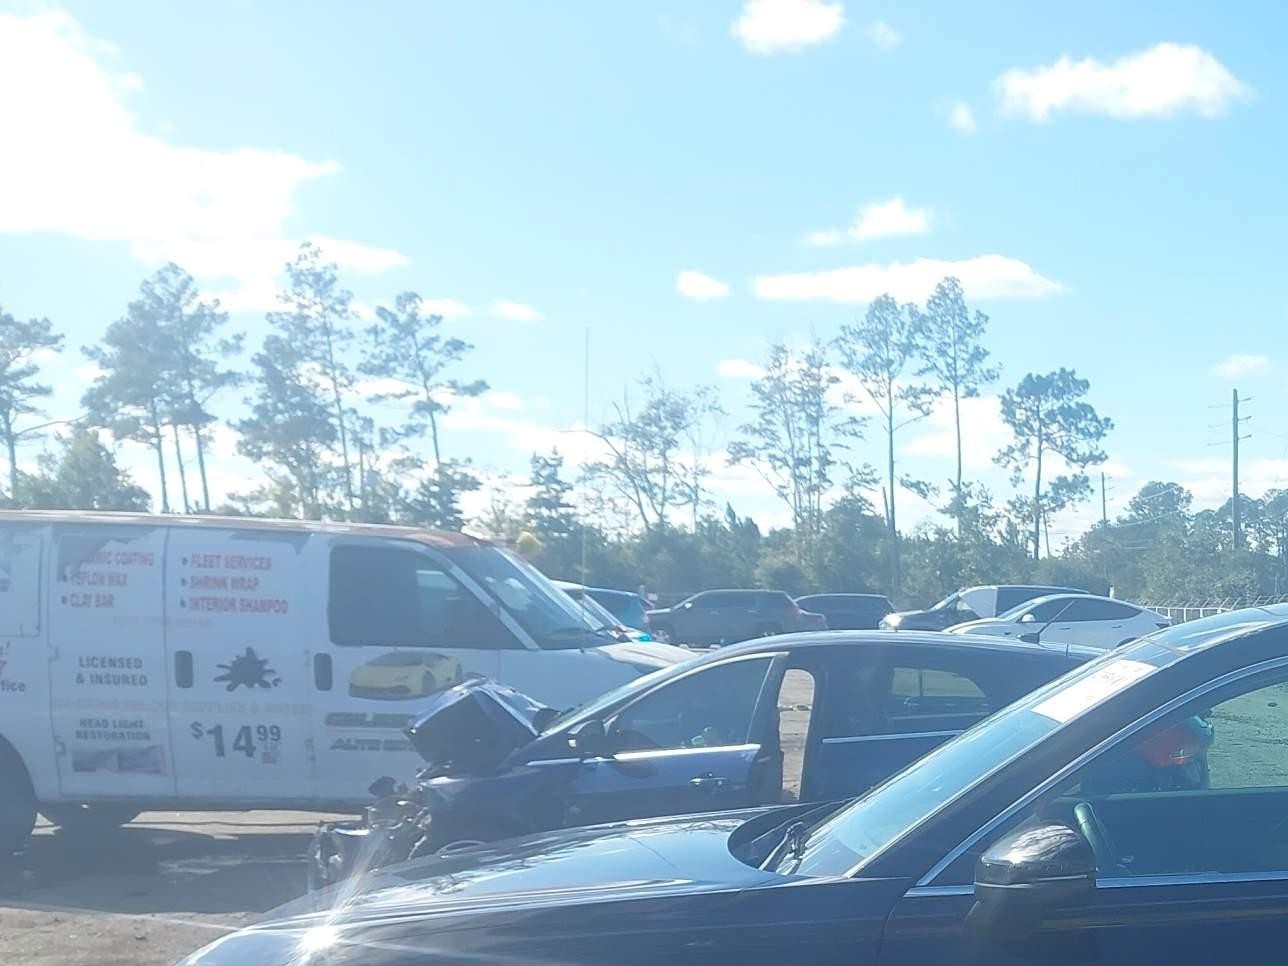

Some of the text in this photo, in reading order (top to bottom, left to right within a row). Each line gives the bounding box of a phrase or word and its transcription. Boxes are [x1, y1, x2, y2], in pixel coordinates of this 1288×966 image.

[190, 554, 272, 570] FLEET SERVICES
[189, 576, 259, 591] SHRINK WRAP
[70, 592, 115, 609] CLAY BAR
[188, 596, 289, 614] INTERIOR SHAMPOO
[78, 656, 144, 669] LICENSED
[75, 672, 148, 687] & INSURED
[79, 718, 144, 729] HEAD LIGHT
[74, 730, 151, 741] RESTORATION
